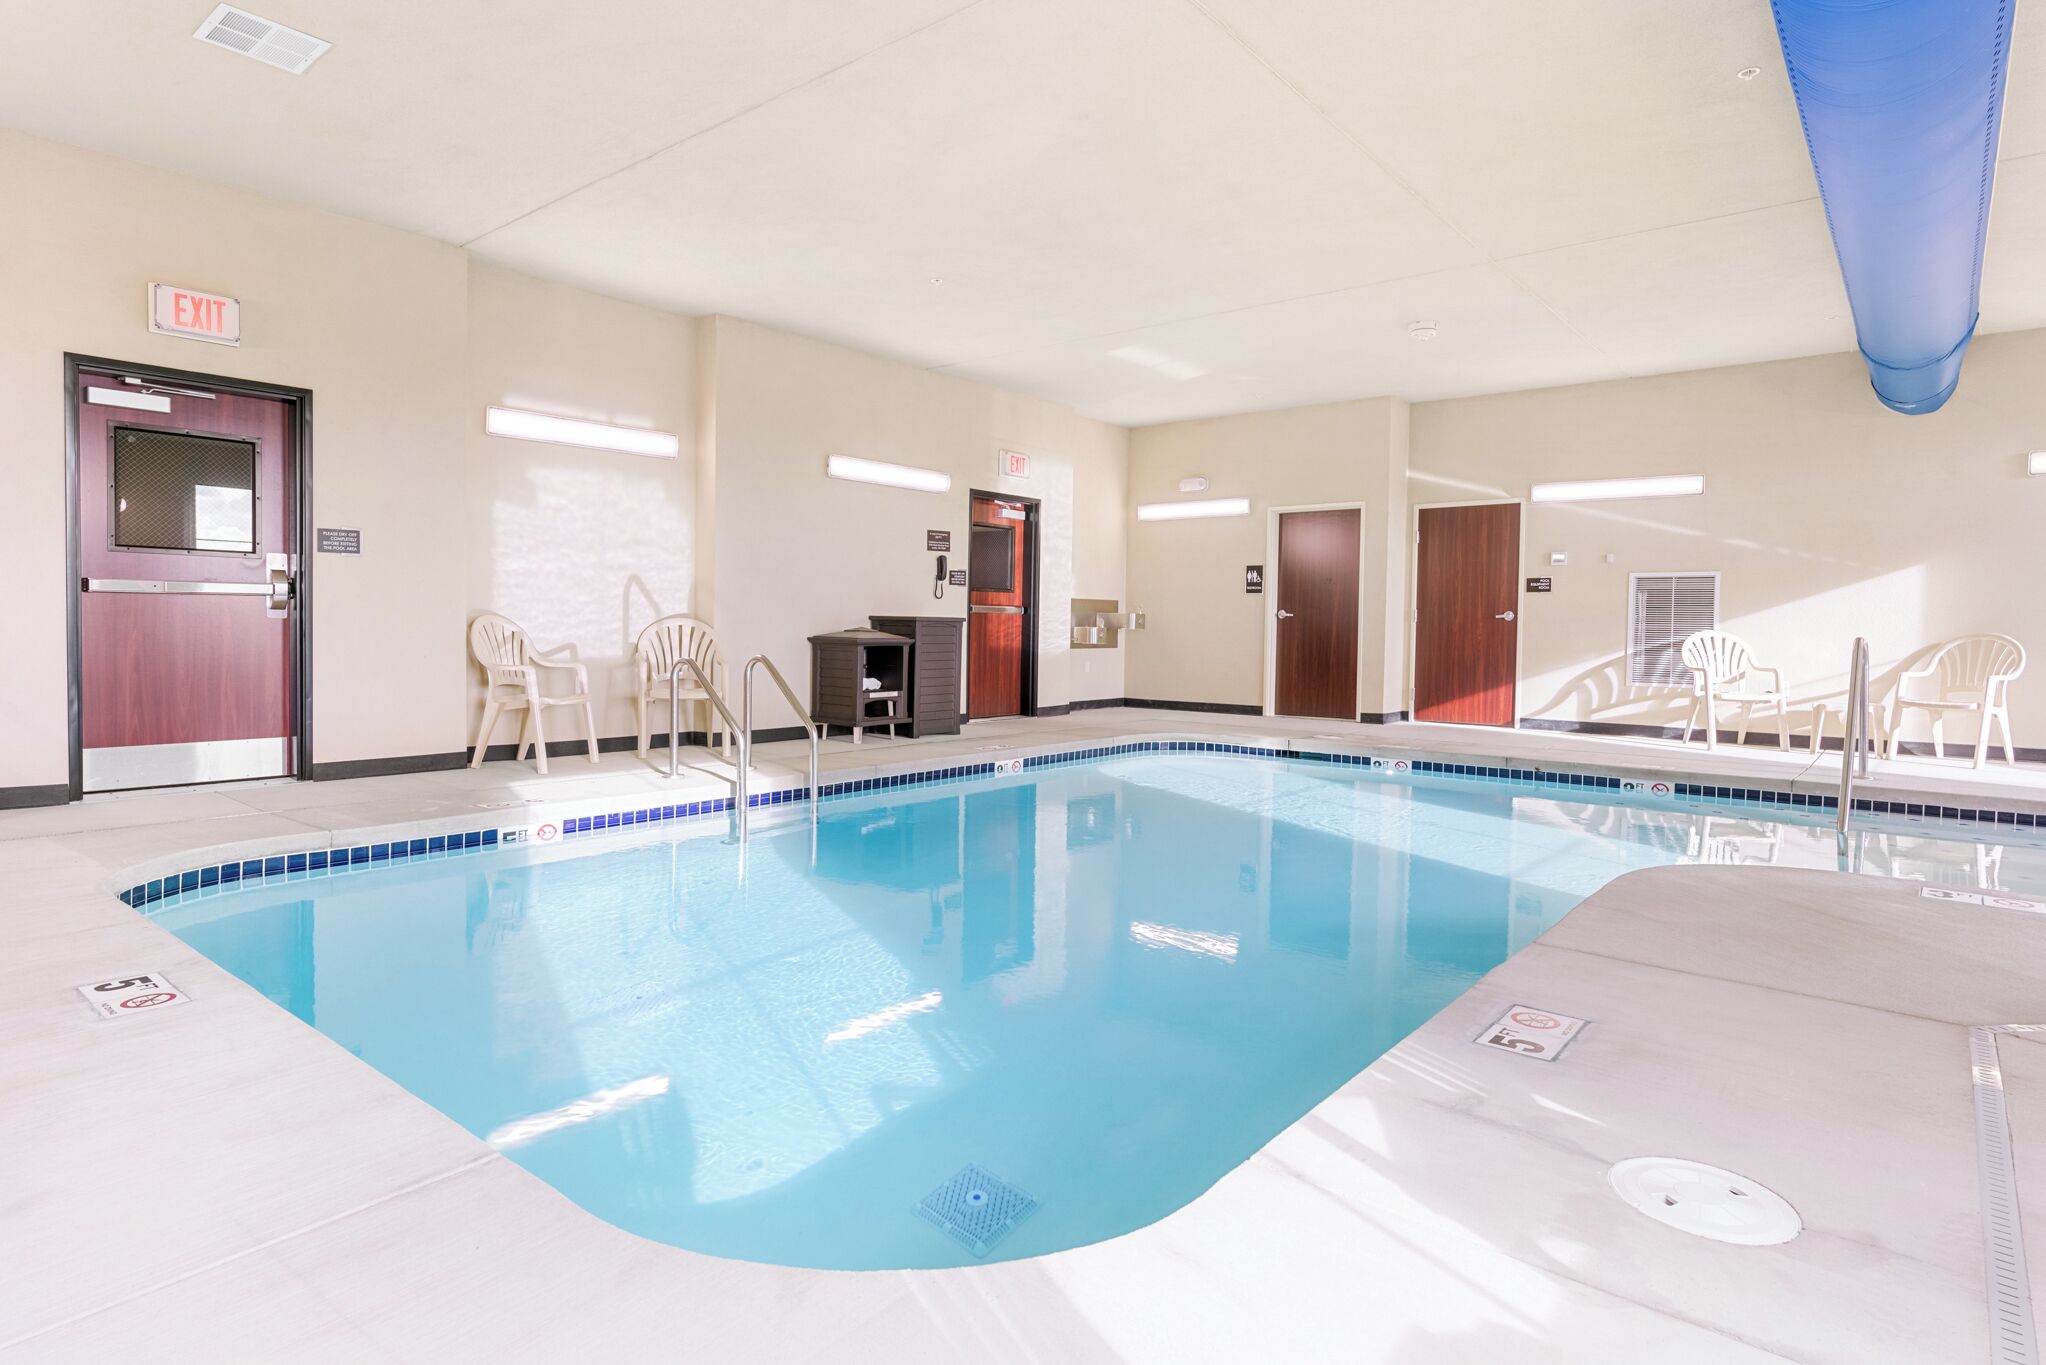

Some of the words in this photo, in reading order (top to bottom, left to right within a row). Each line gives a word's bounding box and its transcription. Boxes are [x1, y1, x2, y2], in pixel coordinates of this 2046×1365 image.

[174, 292, 226, 333] EXIT
[1010, 455, 1026, 475] EXIT
[94, 975, 153, 992] 5
[135, 982, 160, 991] FT
[1498, 1027, 1520, 1038] FT
[1488, 1034, 1545, 1054] 5
